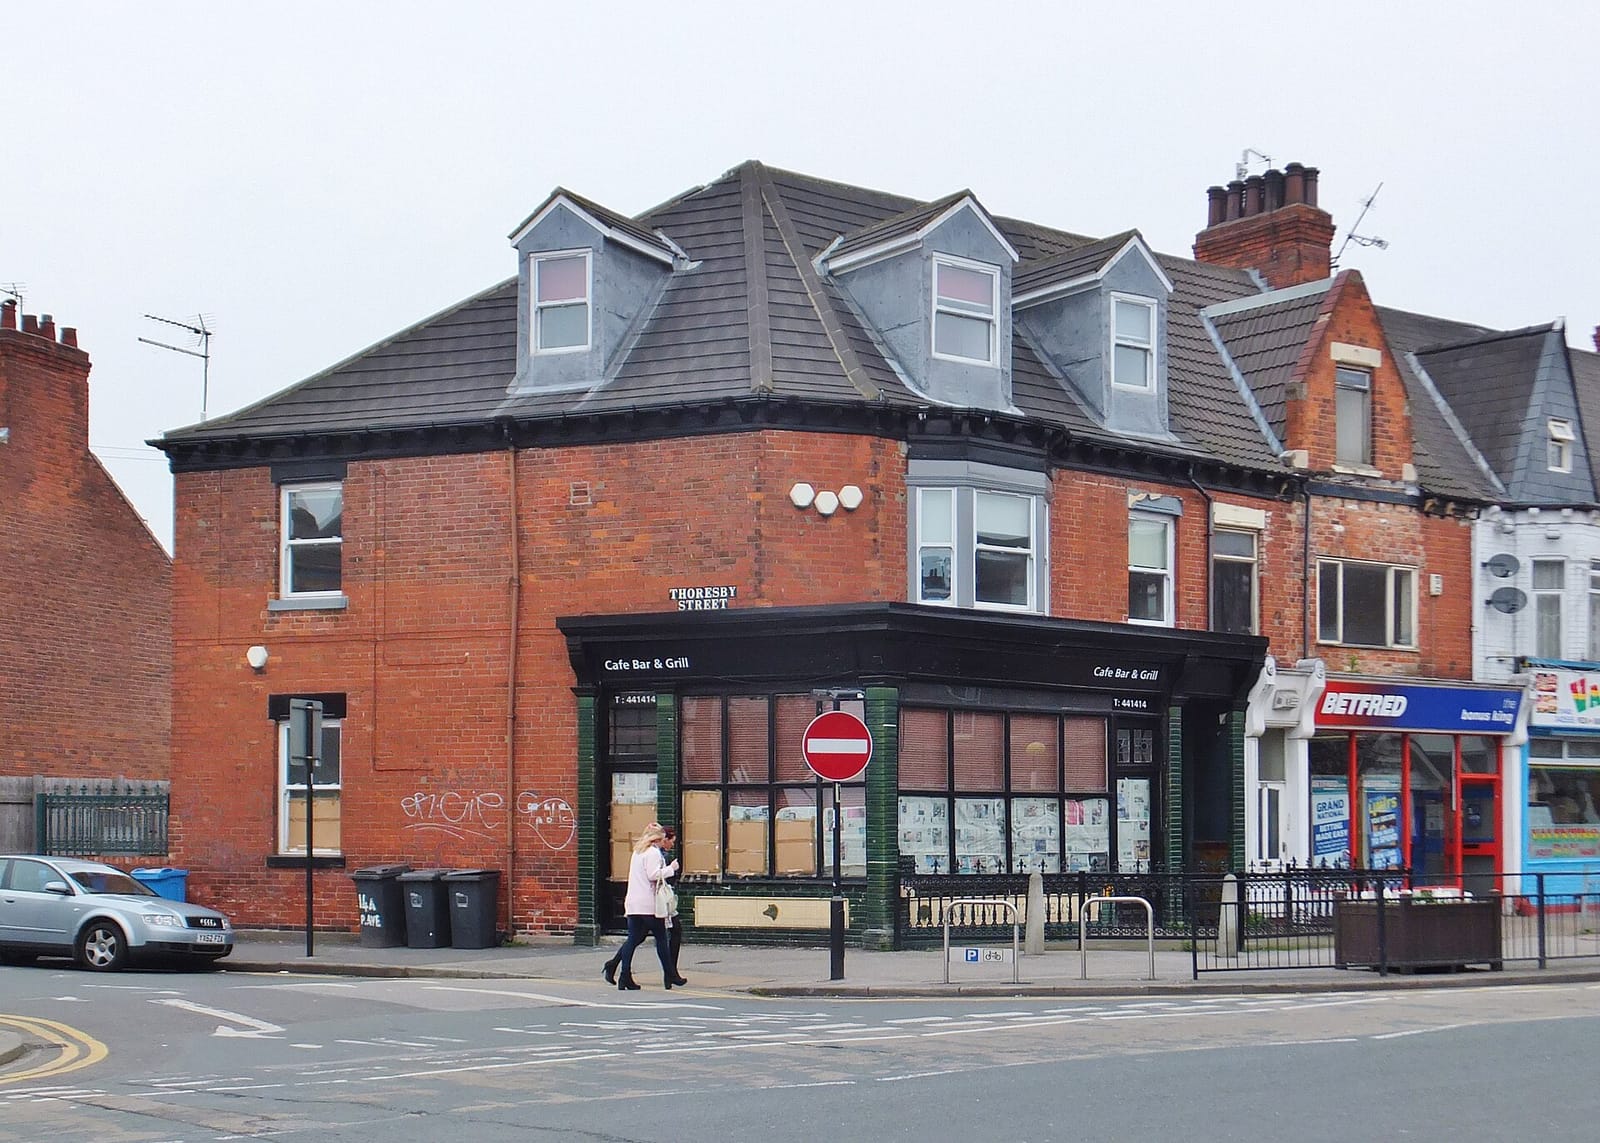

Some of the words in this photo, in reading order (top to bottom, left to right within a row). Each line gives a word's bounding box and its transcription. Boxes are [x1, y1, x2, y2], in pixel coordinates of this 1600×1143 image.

[669, 586, 737, 600] THORESBY
[678, 598, 728, 611] STREET
[604, 659, 630, 671] Cafe
[632, 658, 651, 670] Bar
[653, 658, 663, 669] &
[665, 657, 689, 669] Grill
[1093, 666, 1113, 678] Cafe
[1115, 668, 1130, 679] Bar
[1131, 669, 1139, 680] &
[1140, 670, 1159, 680] Grill
[626, 695, 656, 703] 441414
[1121, 699, 1147, 708] 441414
[1321, 692, 1408, 717] BETFRED
[1460, 709, 1490, 721] bonus
[1492, 710, 1514, 724] king
[1316, 800, 1344, 812] GRAND
[1317, 810, 1344, 819] NATIONAL
